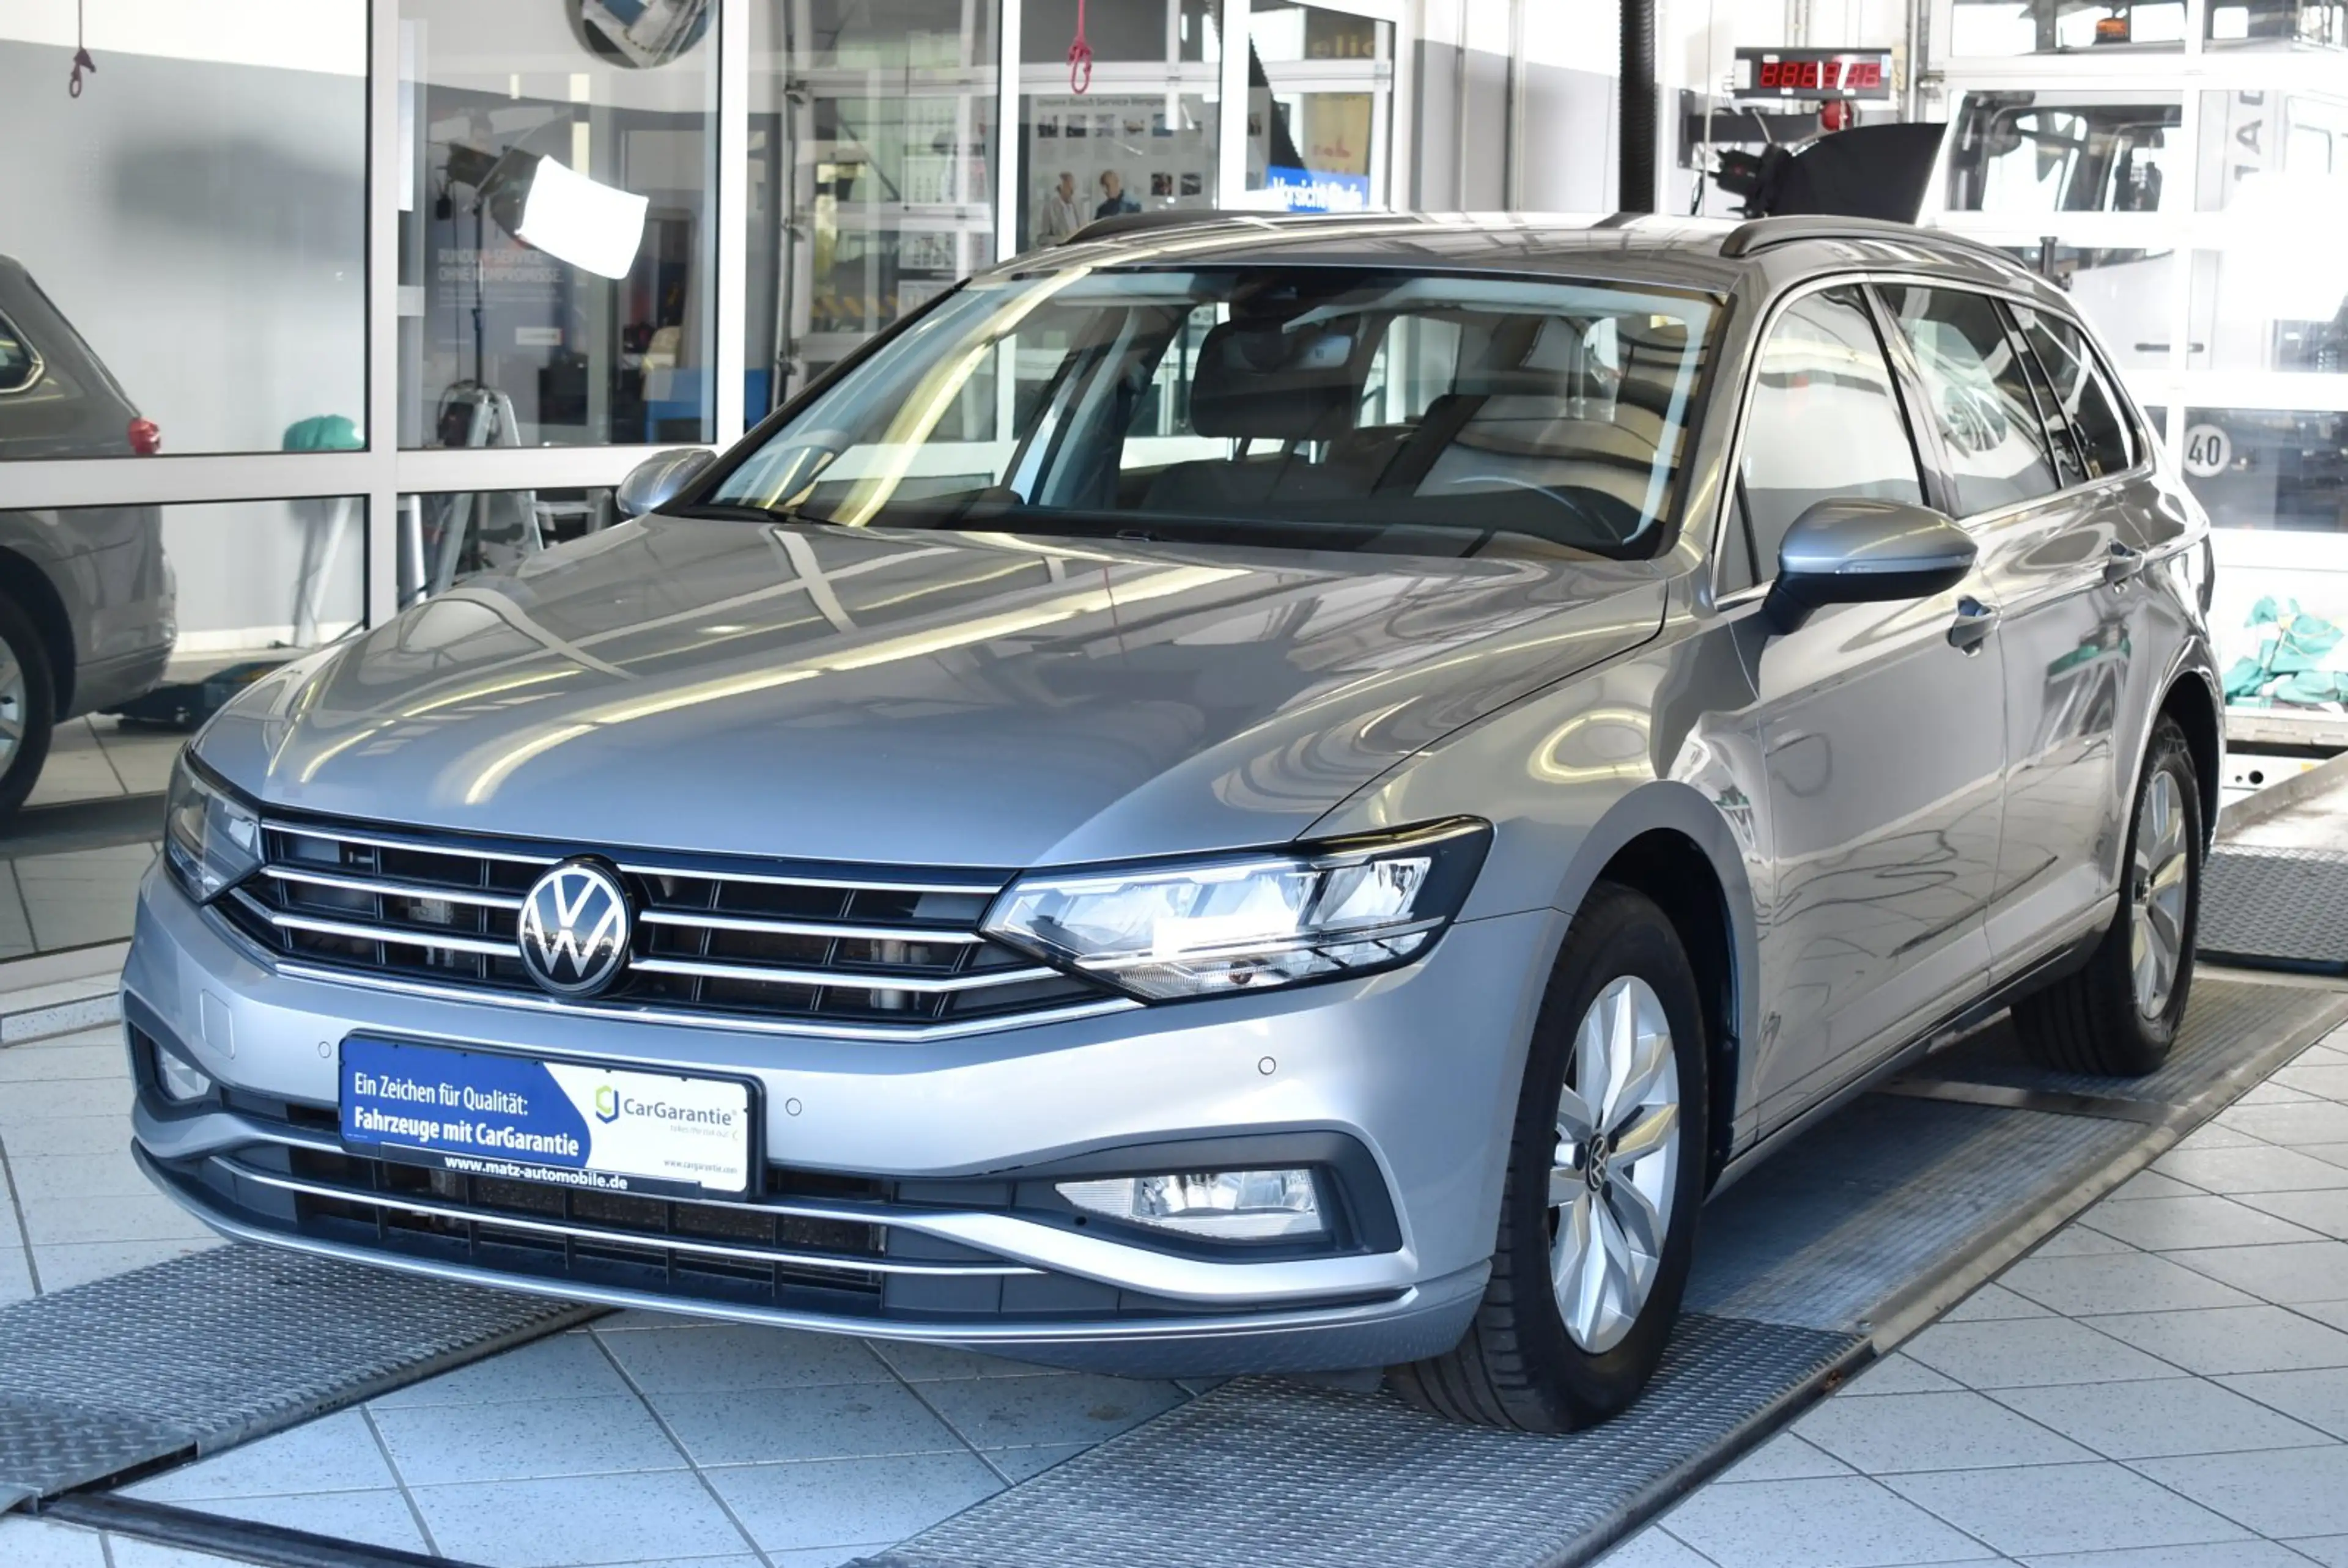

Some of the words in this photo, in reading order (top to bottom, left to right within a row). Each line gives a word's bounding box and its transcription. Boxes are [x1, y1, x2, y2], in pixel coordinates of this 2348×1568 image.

[2188, 434, 2221, 466] 40
[354, 1072, 376, 1096] Ein
[380, 1075, 435, 1103] Zeichen
[438, 1082, 460, 1107] für
[463, 1086, 528, 1116] Qualität:
[354, 1106, 440, 1143] Fahrzeuge
[443, 1119, 473, 1143] mit
[475, 1122, 580, 1157] CarGarantie
[444, 1156, 628, 1190] www.matz-automobile.de
[663, 1159, 738, 1174] www.cargarantie.com
